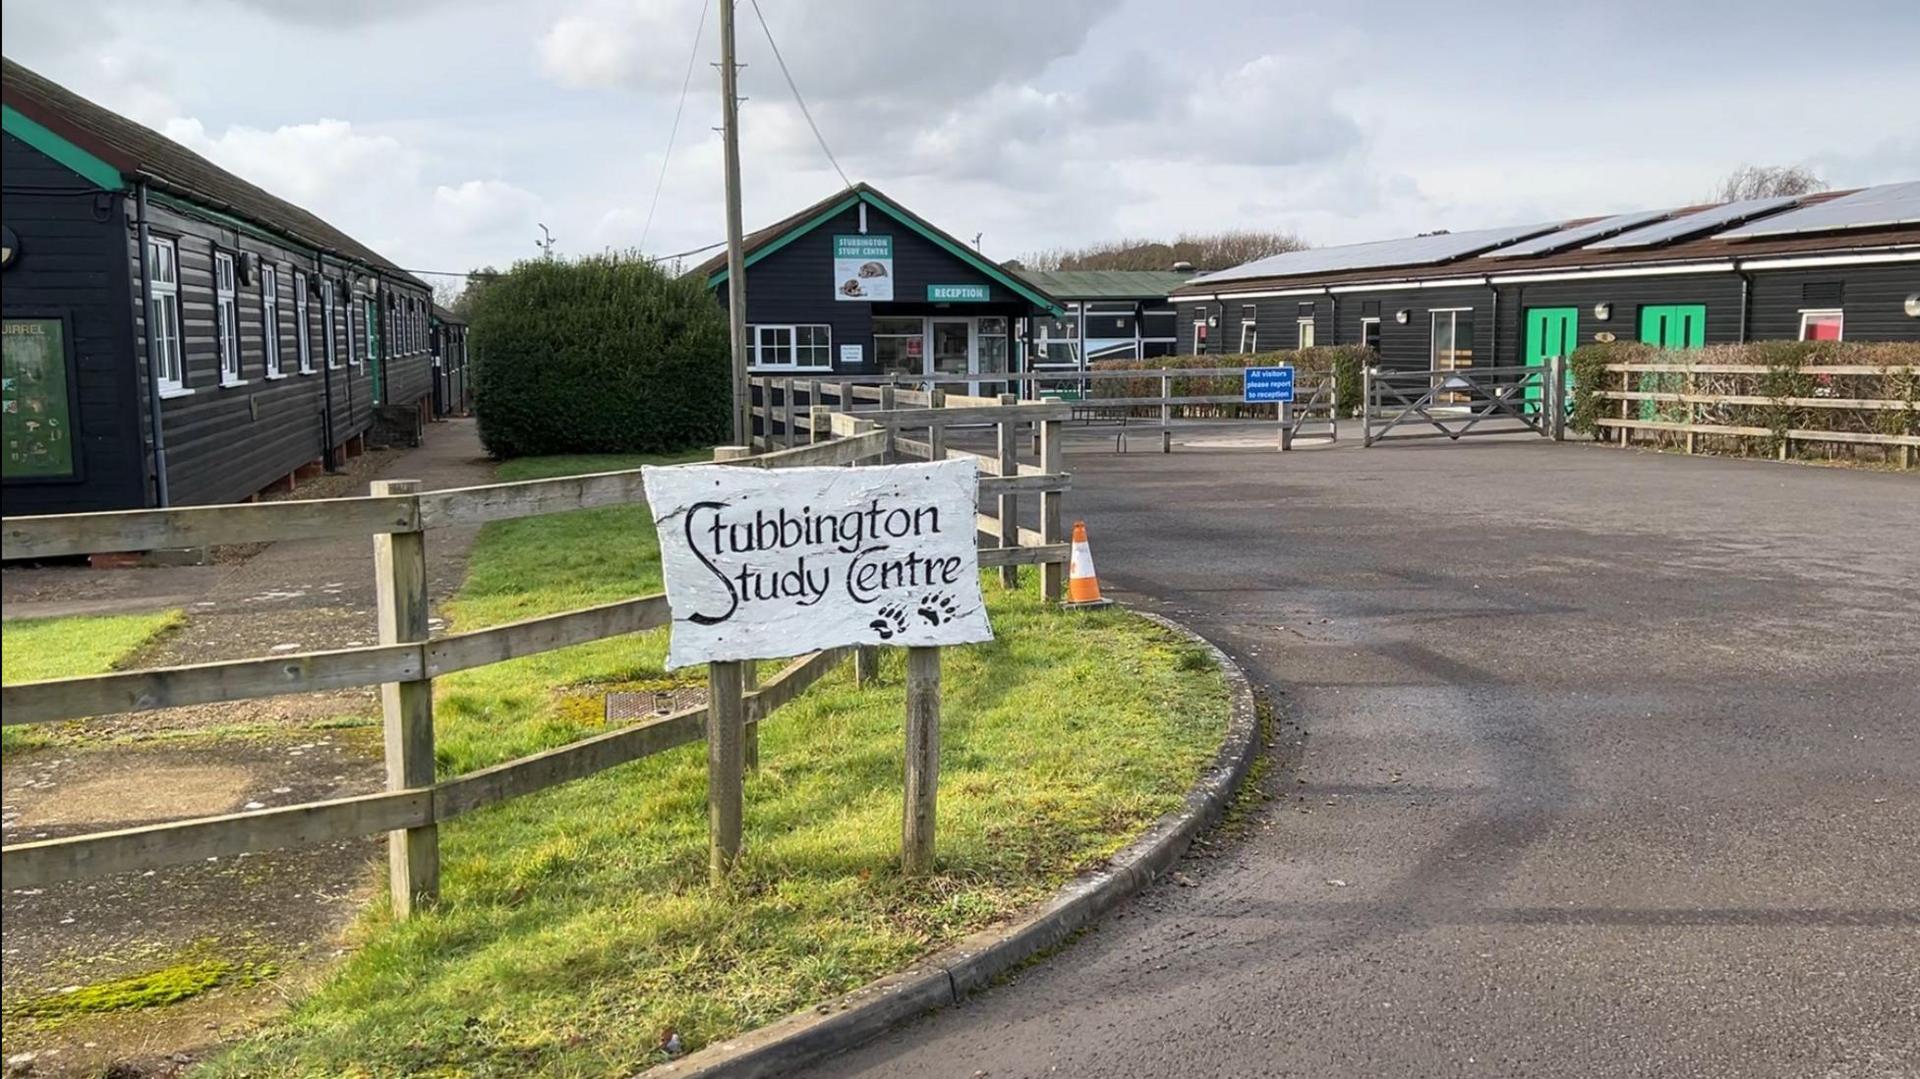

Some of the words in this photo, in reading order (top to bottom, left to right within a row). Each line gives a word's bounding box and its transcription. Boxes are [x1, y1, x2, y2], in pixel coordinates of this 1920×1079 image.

[839, 238, 888, 246] STUBBINGTON
[838, 247, 860, 256] STUDY
[862, 247, 889, 256] CENTRE
[934, 288, 984, 298] RECEPTION
[1247, 381, 1270, 389] please
[1270, 380, 1291, 388] report
[1257, 391, 1289, 399] reception
[685, 499, 941, 562] Stubbington
[687, 556, 829, 625] Study
[846, 545, 962, 604] Centre
